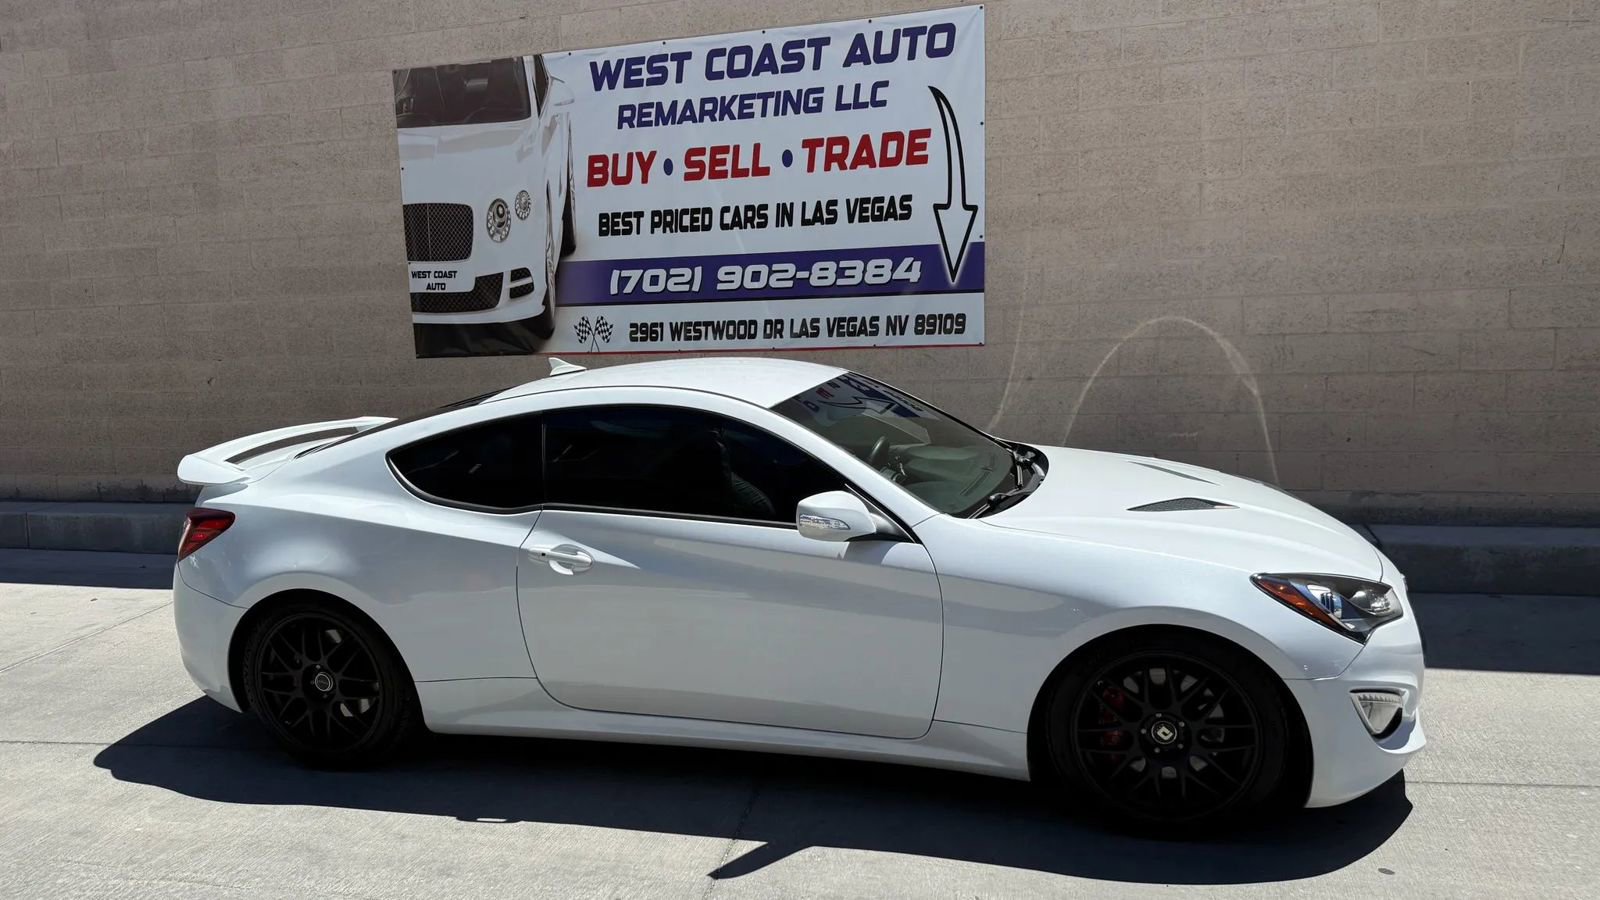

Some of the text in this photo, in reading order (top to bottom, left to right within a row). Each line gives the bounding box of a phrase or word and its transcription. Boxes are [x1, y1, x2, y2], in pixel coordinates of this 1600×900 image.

[590, 23, 956, 91] WEST COAST AUTO
[617, 80, 889, 130] REMARKETING LLC
[587, 128, 931, 187] BUY SELL TRADE
[598, 194, 912, 237] BEST PRICED CARS IN LAS VEGAS
[411, 271, 458, 279] WEST COAST
[610, 257, 922, 295] (702) 902-8384
[629, 313, 966, 342] 2961 WESTWOOD DR LAS VEGAS NV 89109
